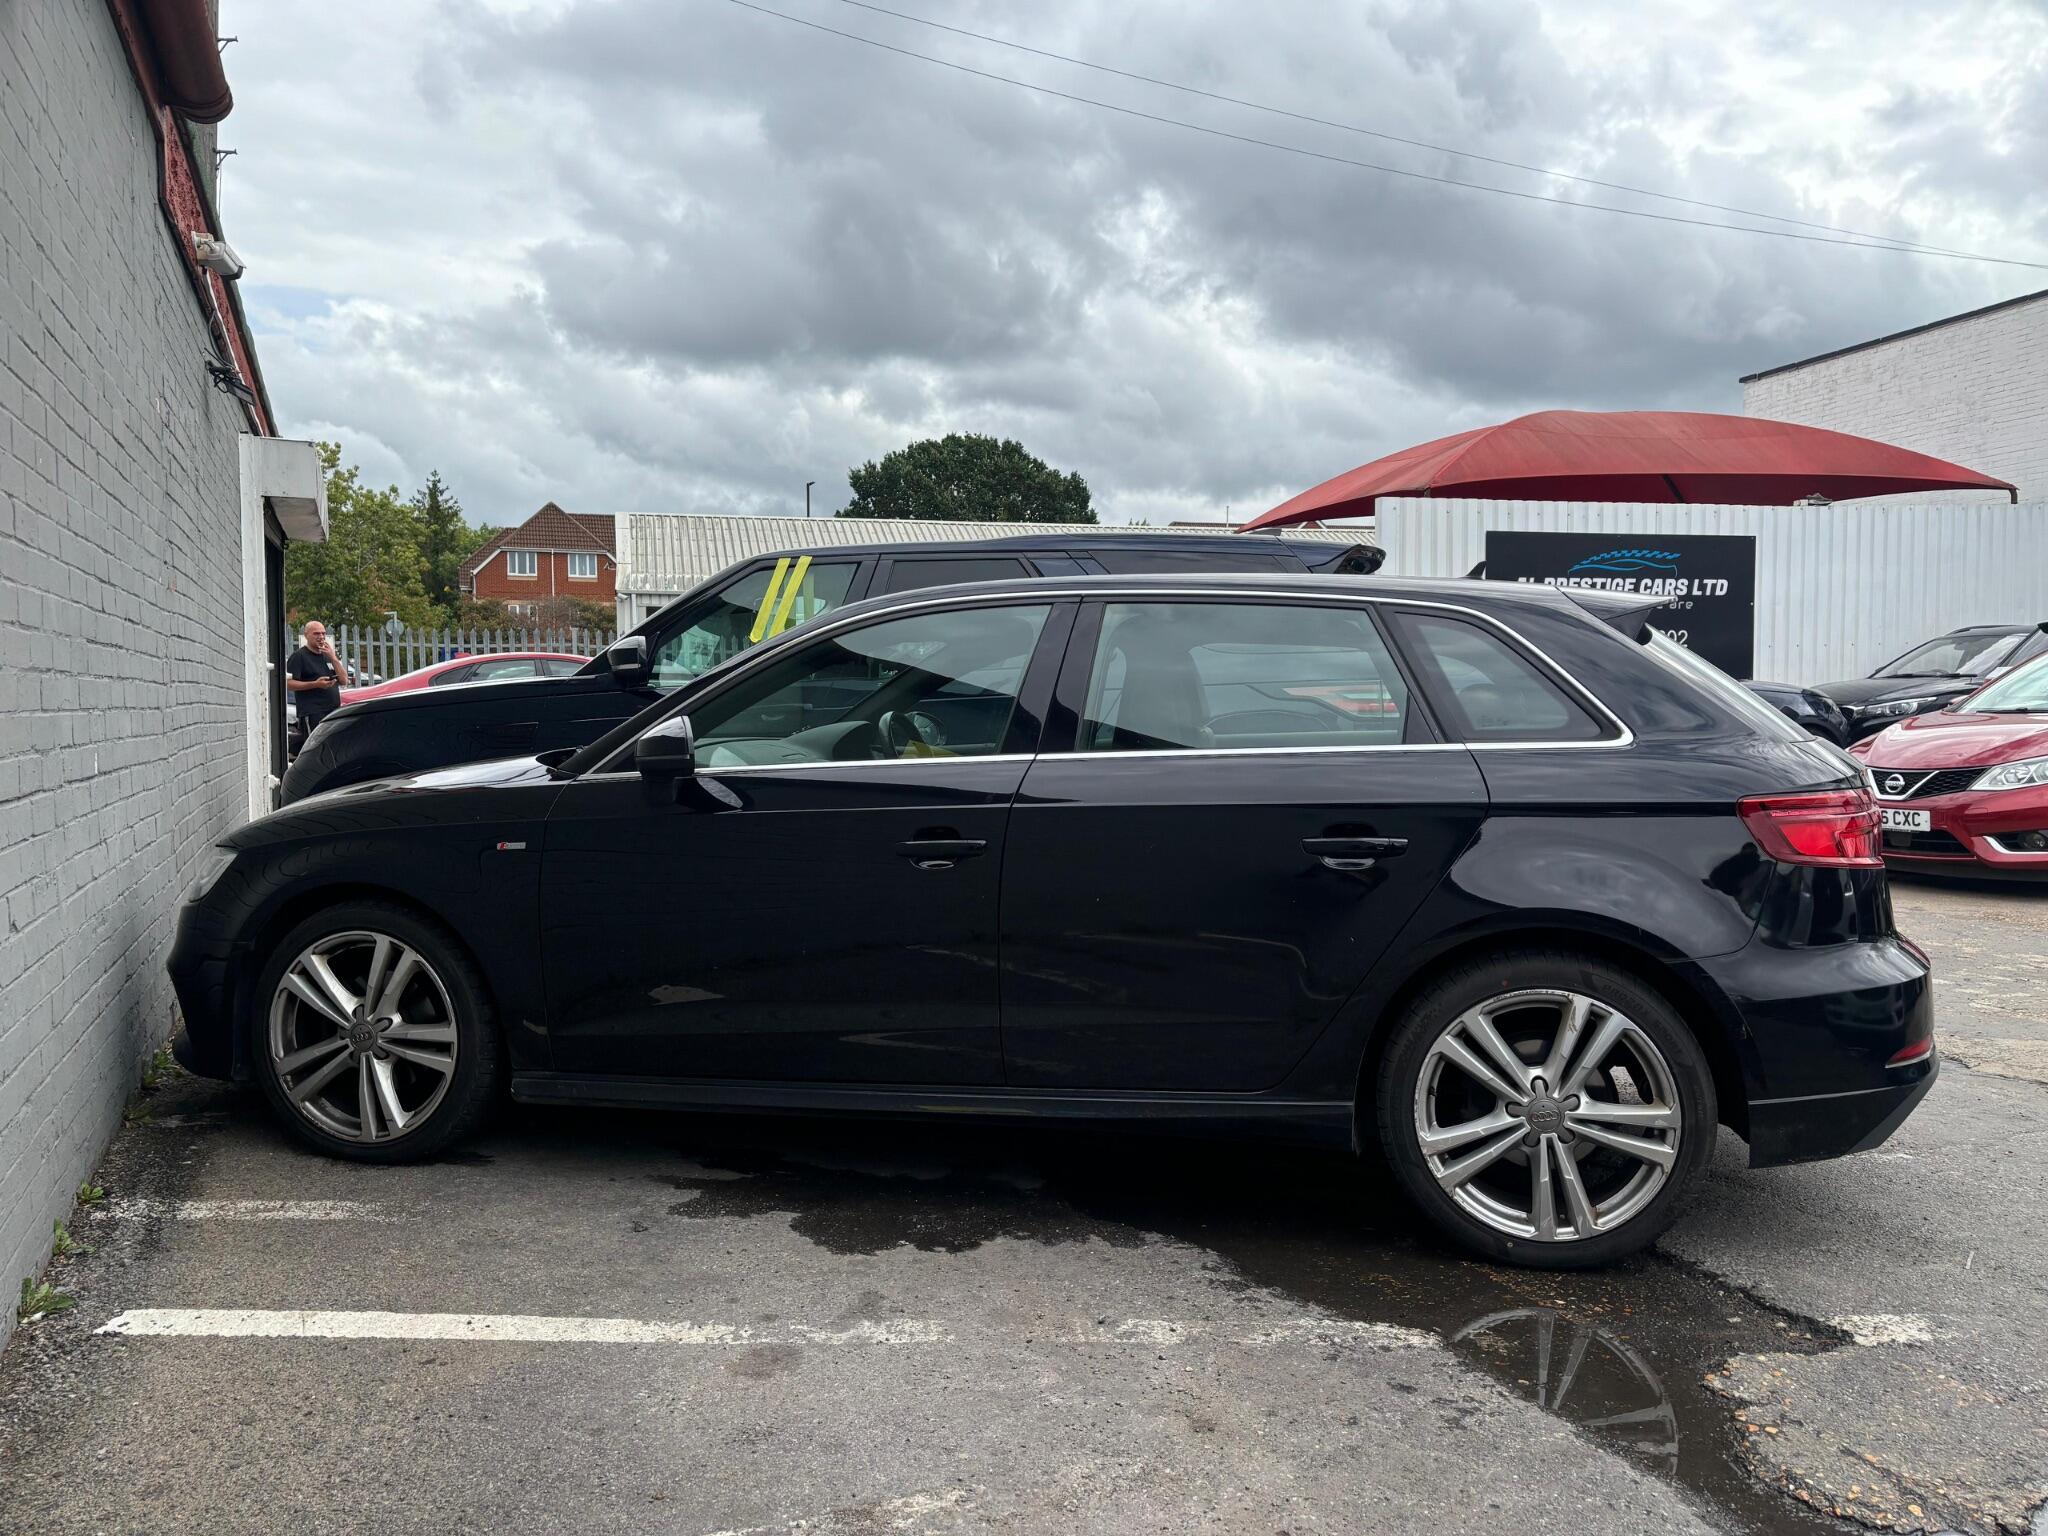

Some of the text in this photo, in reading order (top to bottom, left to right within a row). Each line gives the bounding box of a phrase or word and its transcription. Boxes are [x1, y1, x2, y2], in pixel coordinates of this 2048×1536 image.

[1639, 578, 1688, 595] CARS
[1692, 578, 1729, 596] LTD
[1893, 810, 1921, 827] CXC
